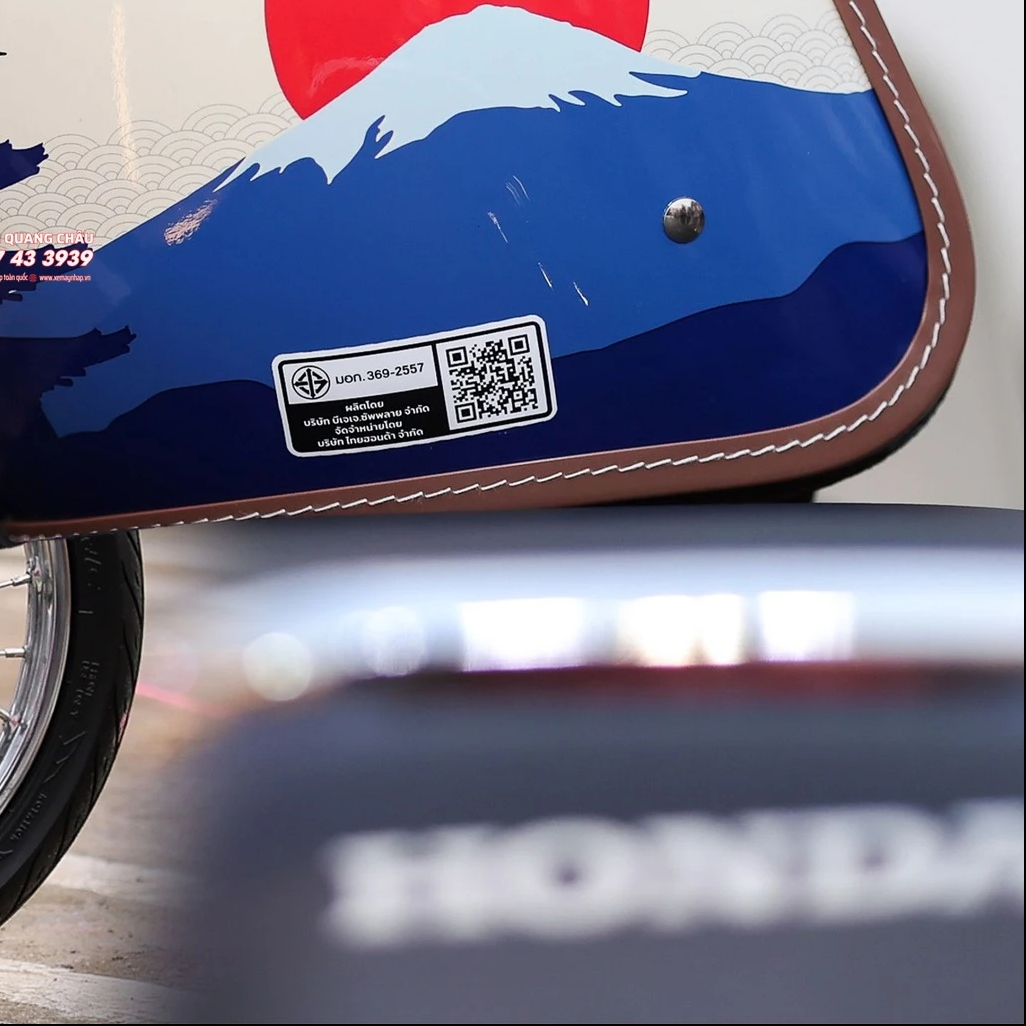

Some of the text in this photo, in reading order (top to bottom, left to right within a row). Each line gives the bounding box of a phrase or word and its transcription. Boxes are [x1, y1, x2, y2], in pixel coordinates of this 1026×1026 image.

[335, 362, 425, 385] มอก. 369-2557
[303, 416, 330, 427] บริษัท
[404, 404, 430, 416] จำกัด
[345, 400, 384, 412] ผลิตโดย
[317, 427, 424, 448] บริษัท ไทยฮอนด้า จำกัด
[335, 420, 403, 435] จัดจำหน่ายโดย
